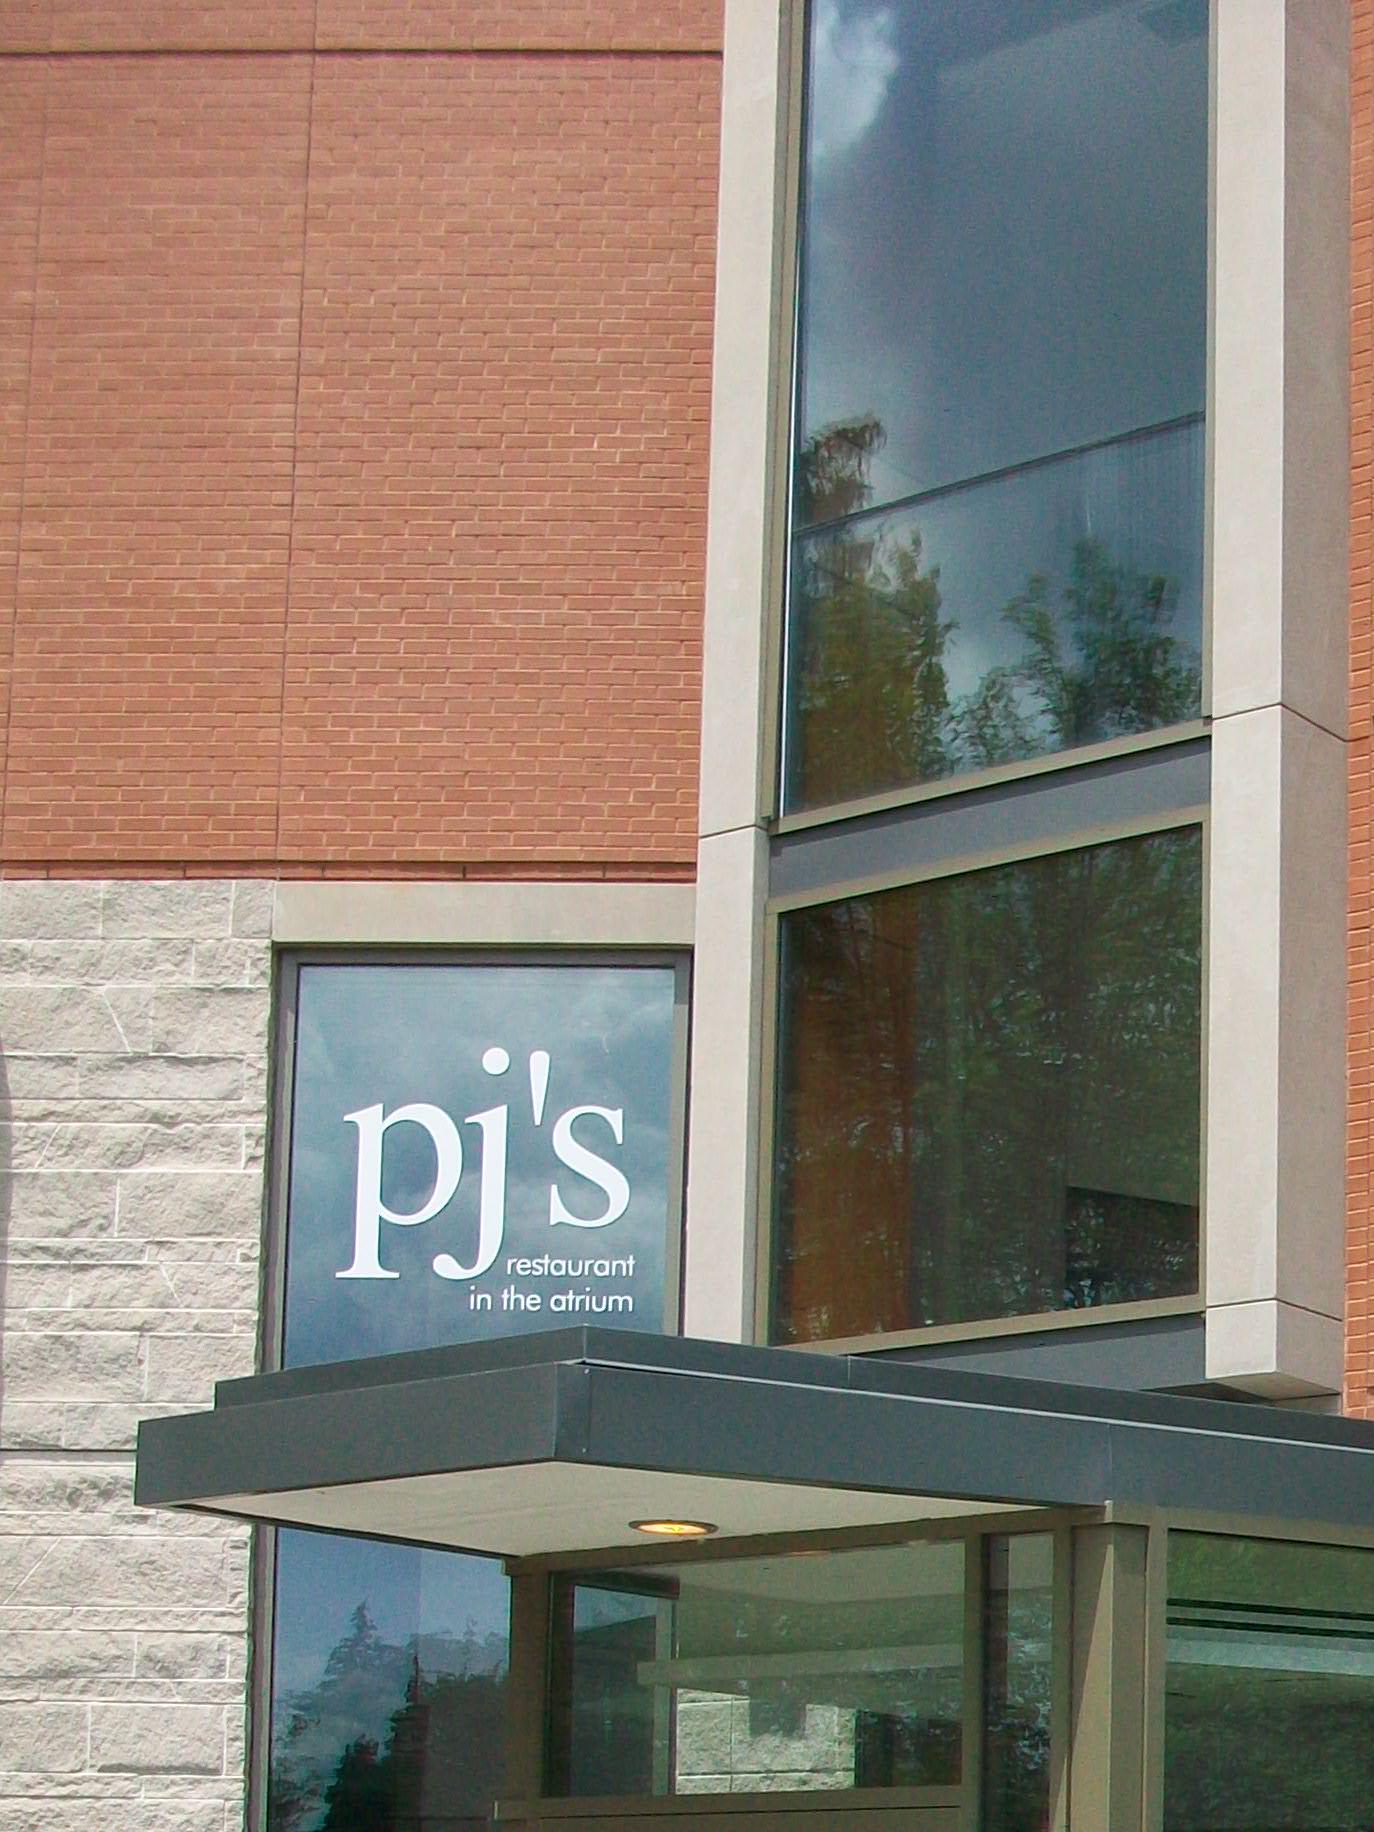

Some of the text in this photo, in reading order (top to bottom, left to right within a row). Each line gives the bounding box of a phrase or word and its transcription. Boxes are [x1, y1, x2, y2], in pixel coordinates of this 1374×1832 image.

[336, 1047, 630, 1280] pj's
[507, 1254, 636, 1276] restaurant
[469, 1285, 633, 1312] in the atrium
